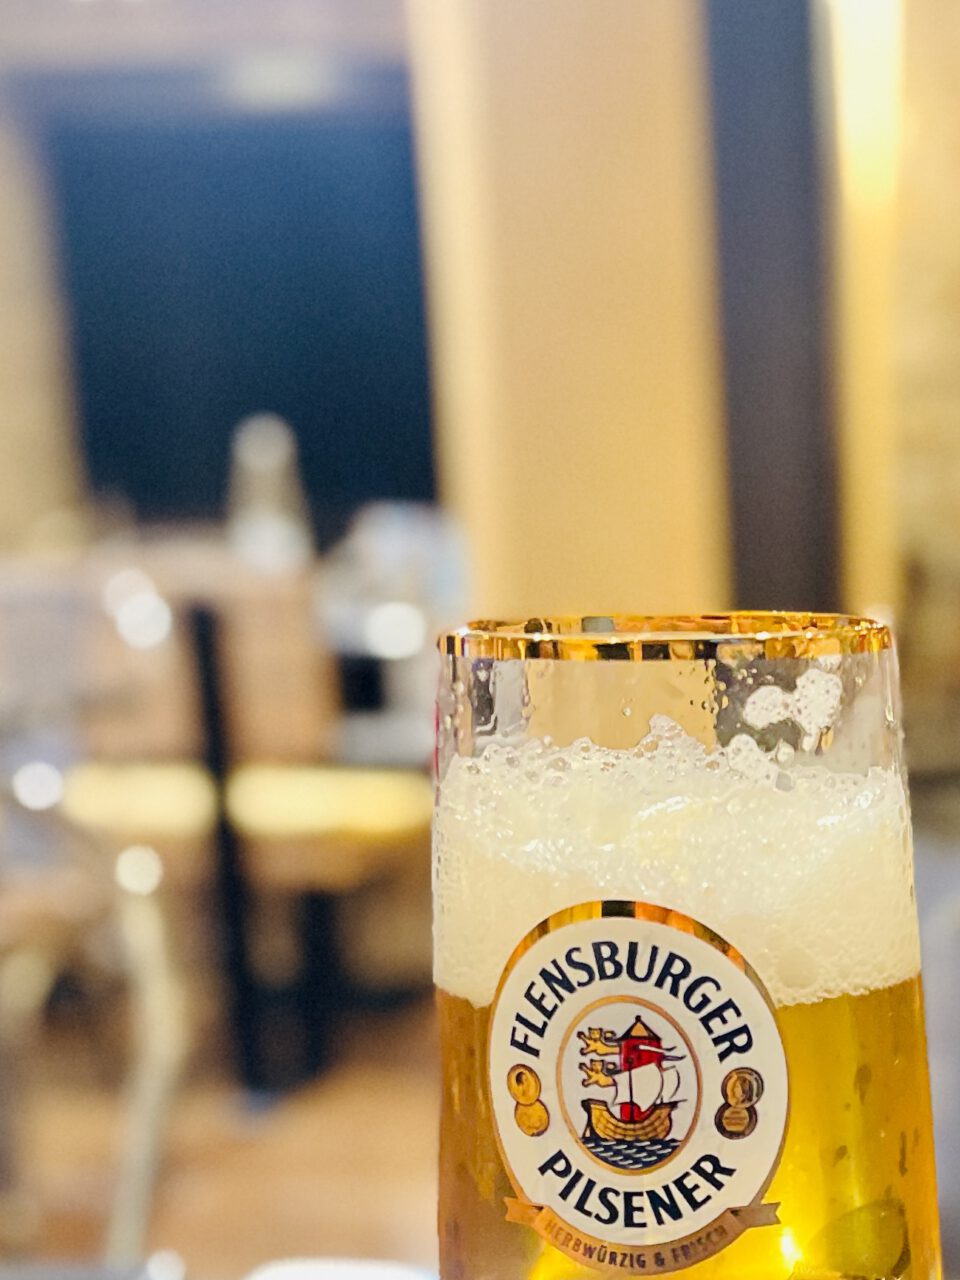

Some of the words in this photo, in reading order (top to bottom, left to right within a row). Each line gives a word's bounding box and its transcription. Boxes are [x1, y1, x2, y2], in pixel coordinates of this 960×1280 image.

[510, 941, 754, 1062] FLENSBURGER
[538, 1149, 736, 1228] PILSENER
[543, 1220, 646, 1269] HERBWÜRZIG
[654, 1253, 665, 1267] &
